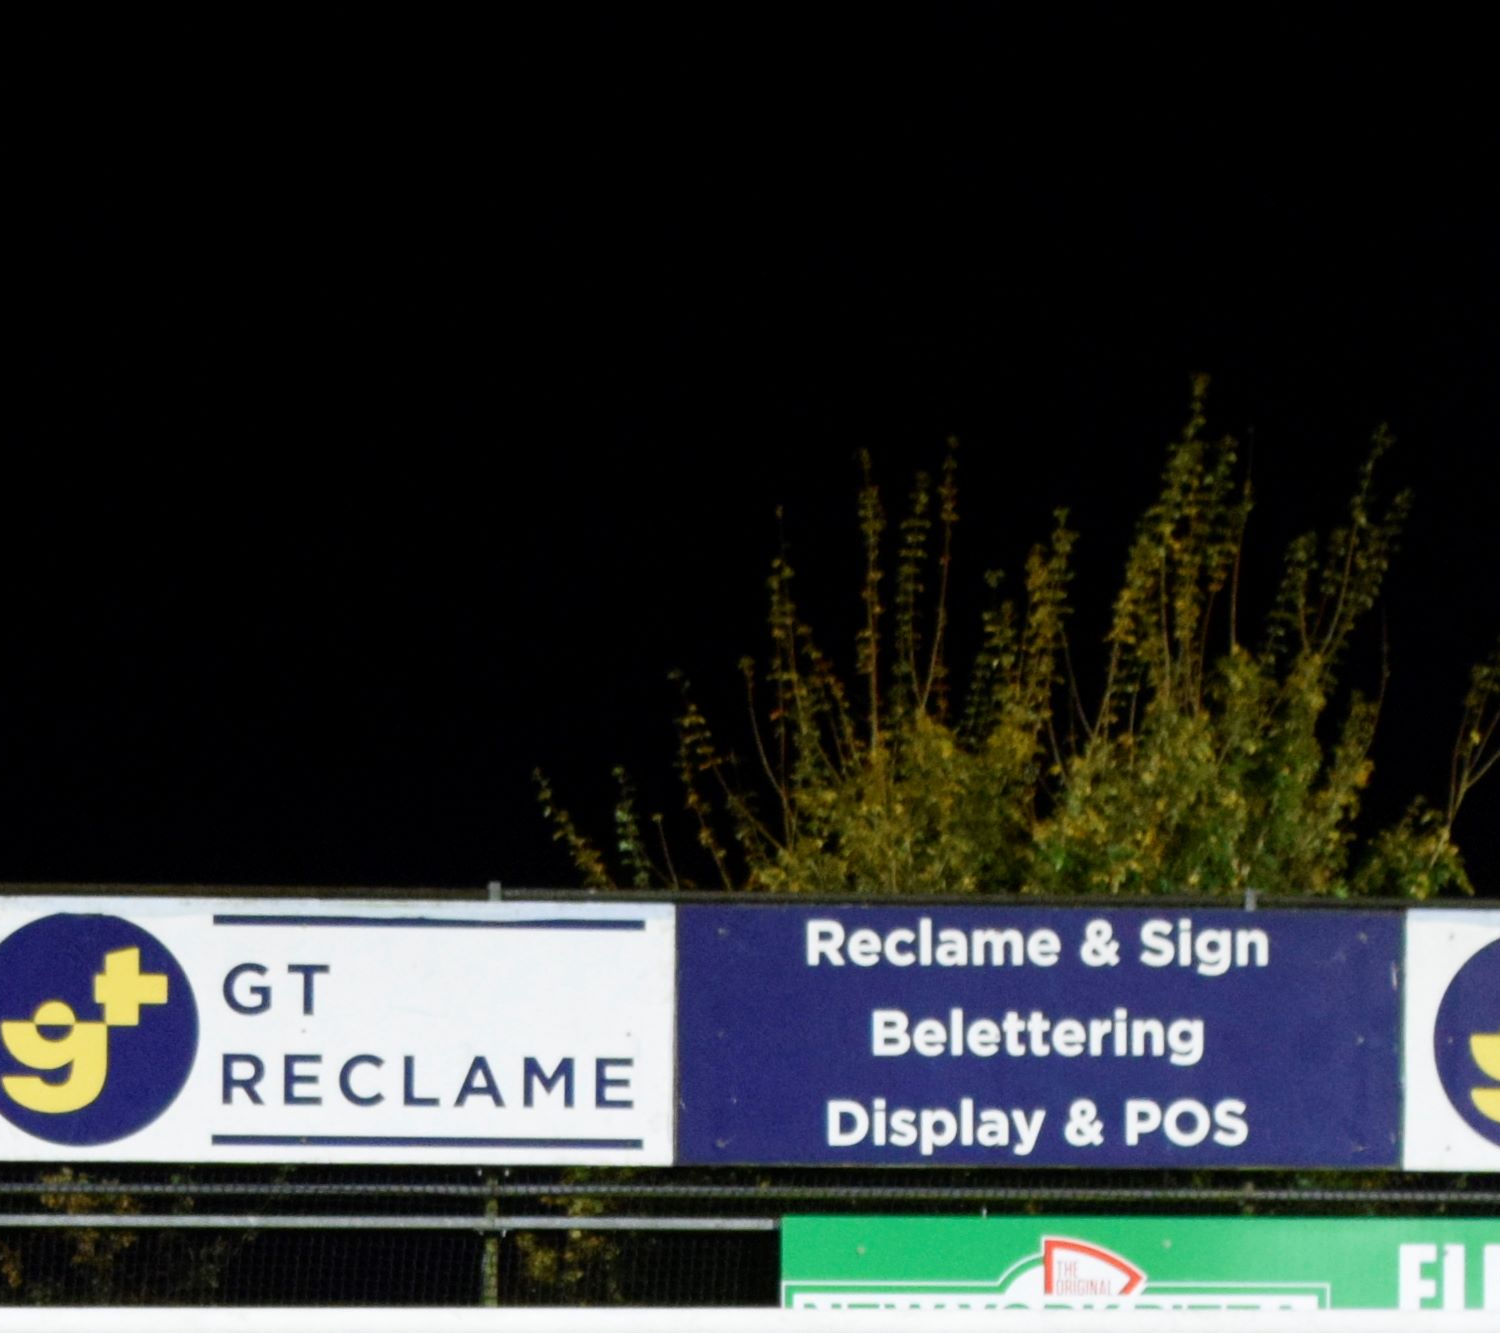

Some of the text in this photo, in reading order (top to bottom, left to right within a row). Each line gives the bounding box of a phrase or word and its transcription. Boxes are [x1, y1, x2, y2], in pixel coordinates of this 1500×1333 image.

[807, 918, 1268, 975] Reclame & Sign
[224, 963, 328, 1014] GT
[873, 1008, 1203, 1065] Belettering
[223, 1054, 632, 1107] RECLAME
[828, 1099, 1248, 1155] Display & POS
